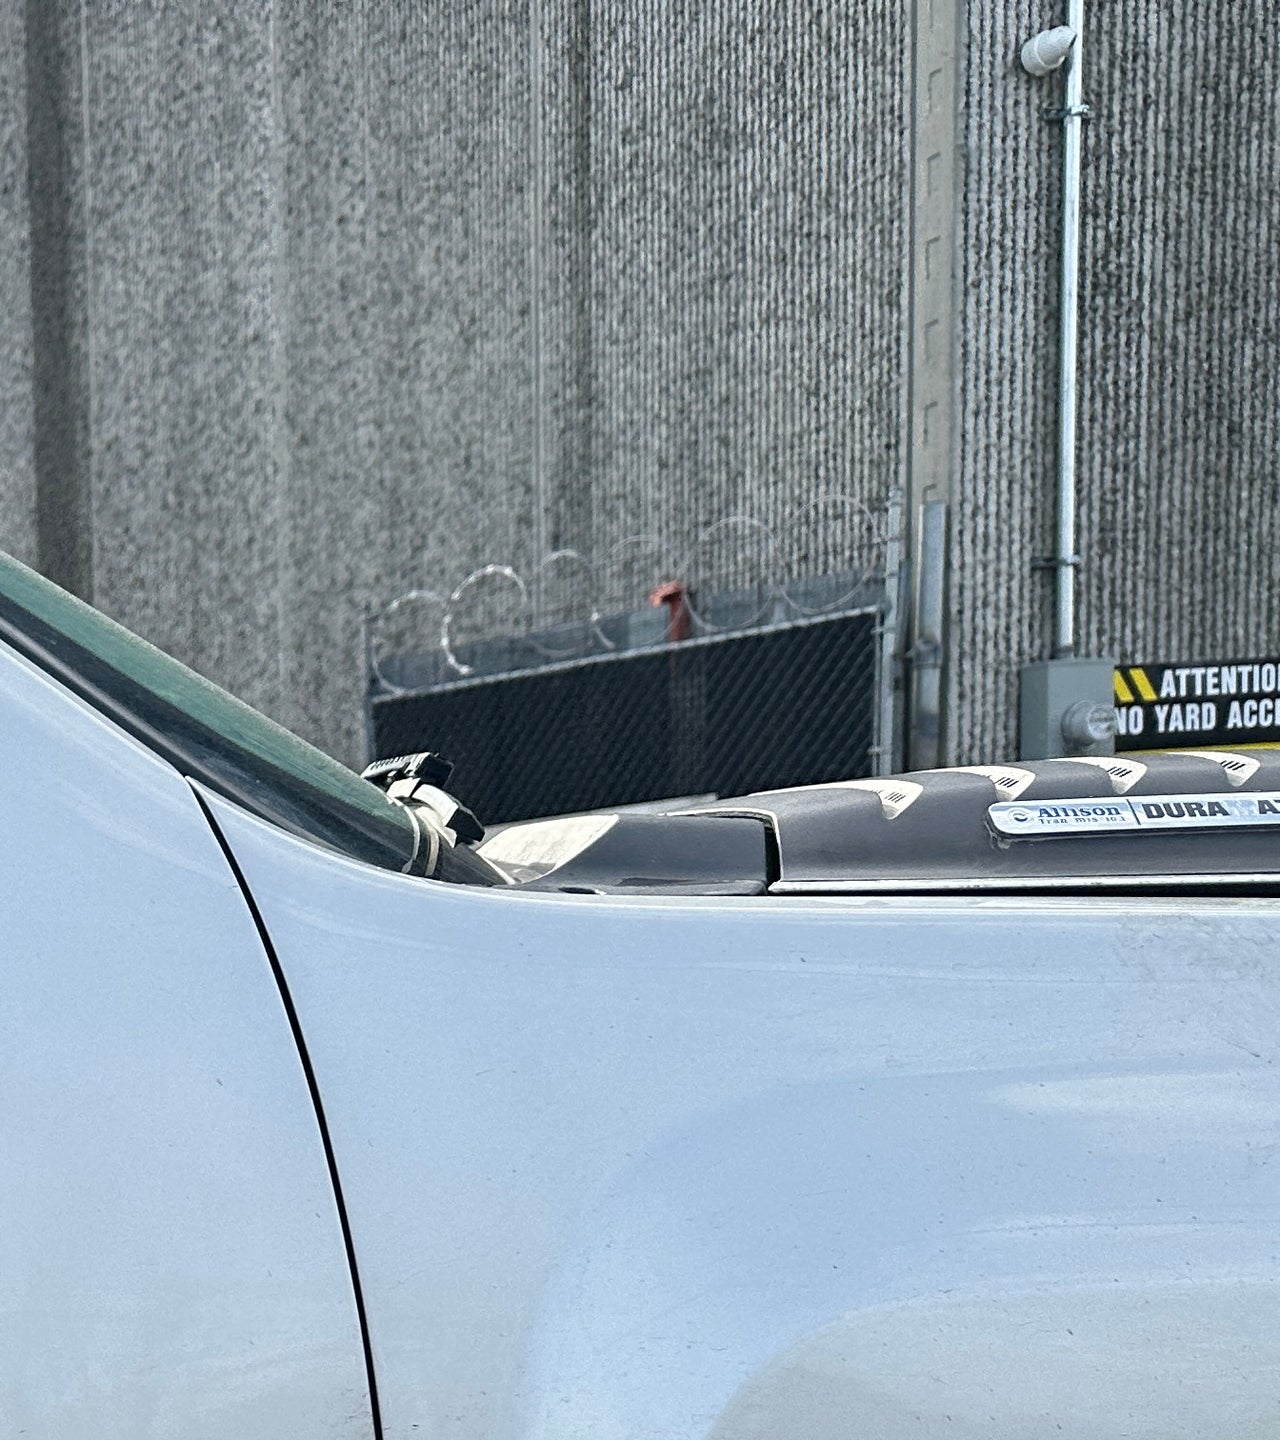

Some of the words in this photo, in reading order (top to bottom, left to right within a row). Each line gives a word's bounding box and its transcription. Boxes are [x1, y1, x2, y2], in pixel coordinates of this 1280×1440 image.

[1160, 663, 1280, 697] ATTENTIO
[1154, 702, 1216, 733] YARD
[1038, 806, 1122, 818] Allison
